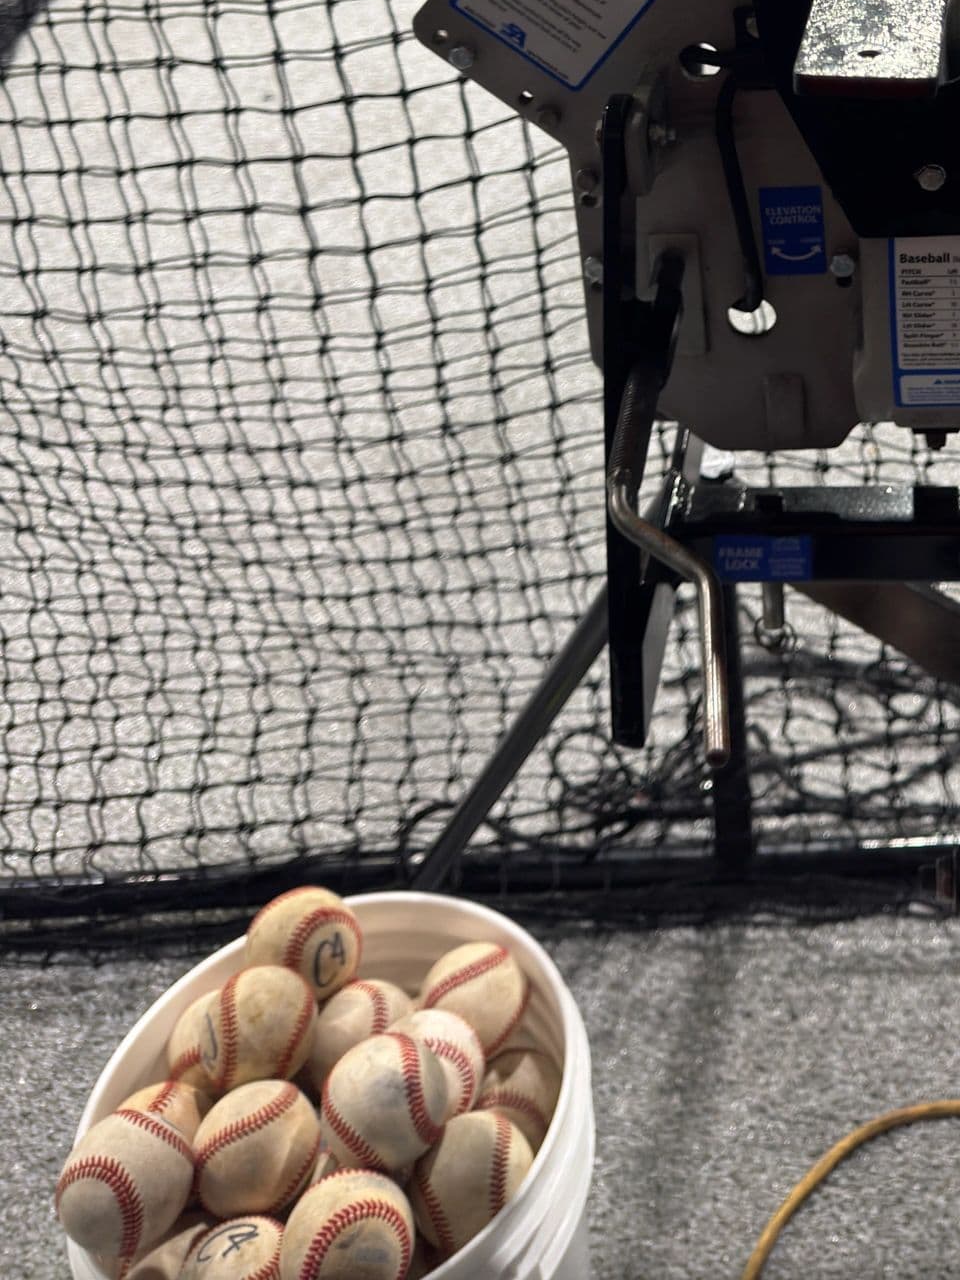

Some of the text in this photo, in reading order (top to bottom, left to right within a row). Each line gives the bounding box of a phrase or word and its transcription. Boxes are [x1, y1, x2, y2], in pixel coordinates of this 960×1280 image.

[765, 206, 821, 216] ELEVATION
[770, 215, 817, 225] CONTROL
[899, 253, 951, 265] Baseball
[718, 547, 763, 559] FRAME
[725, 559, 760, 571] LOCK
